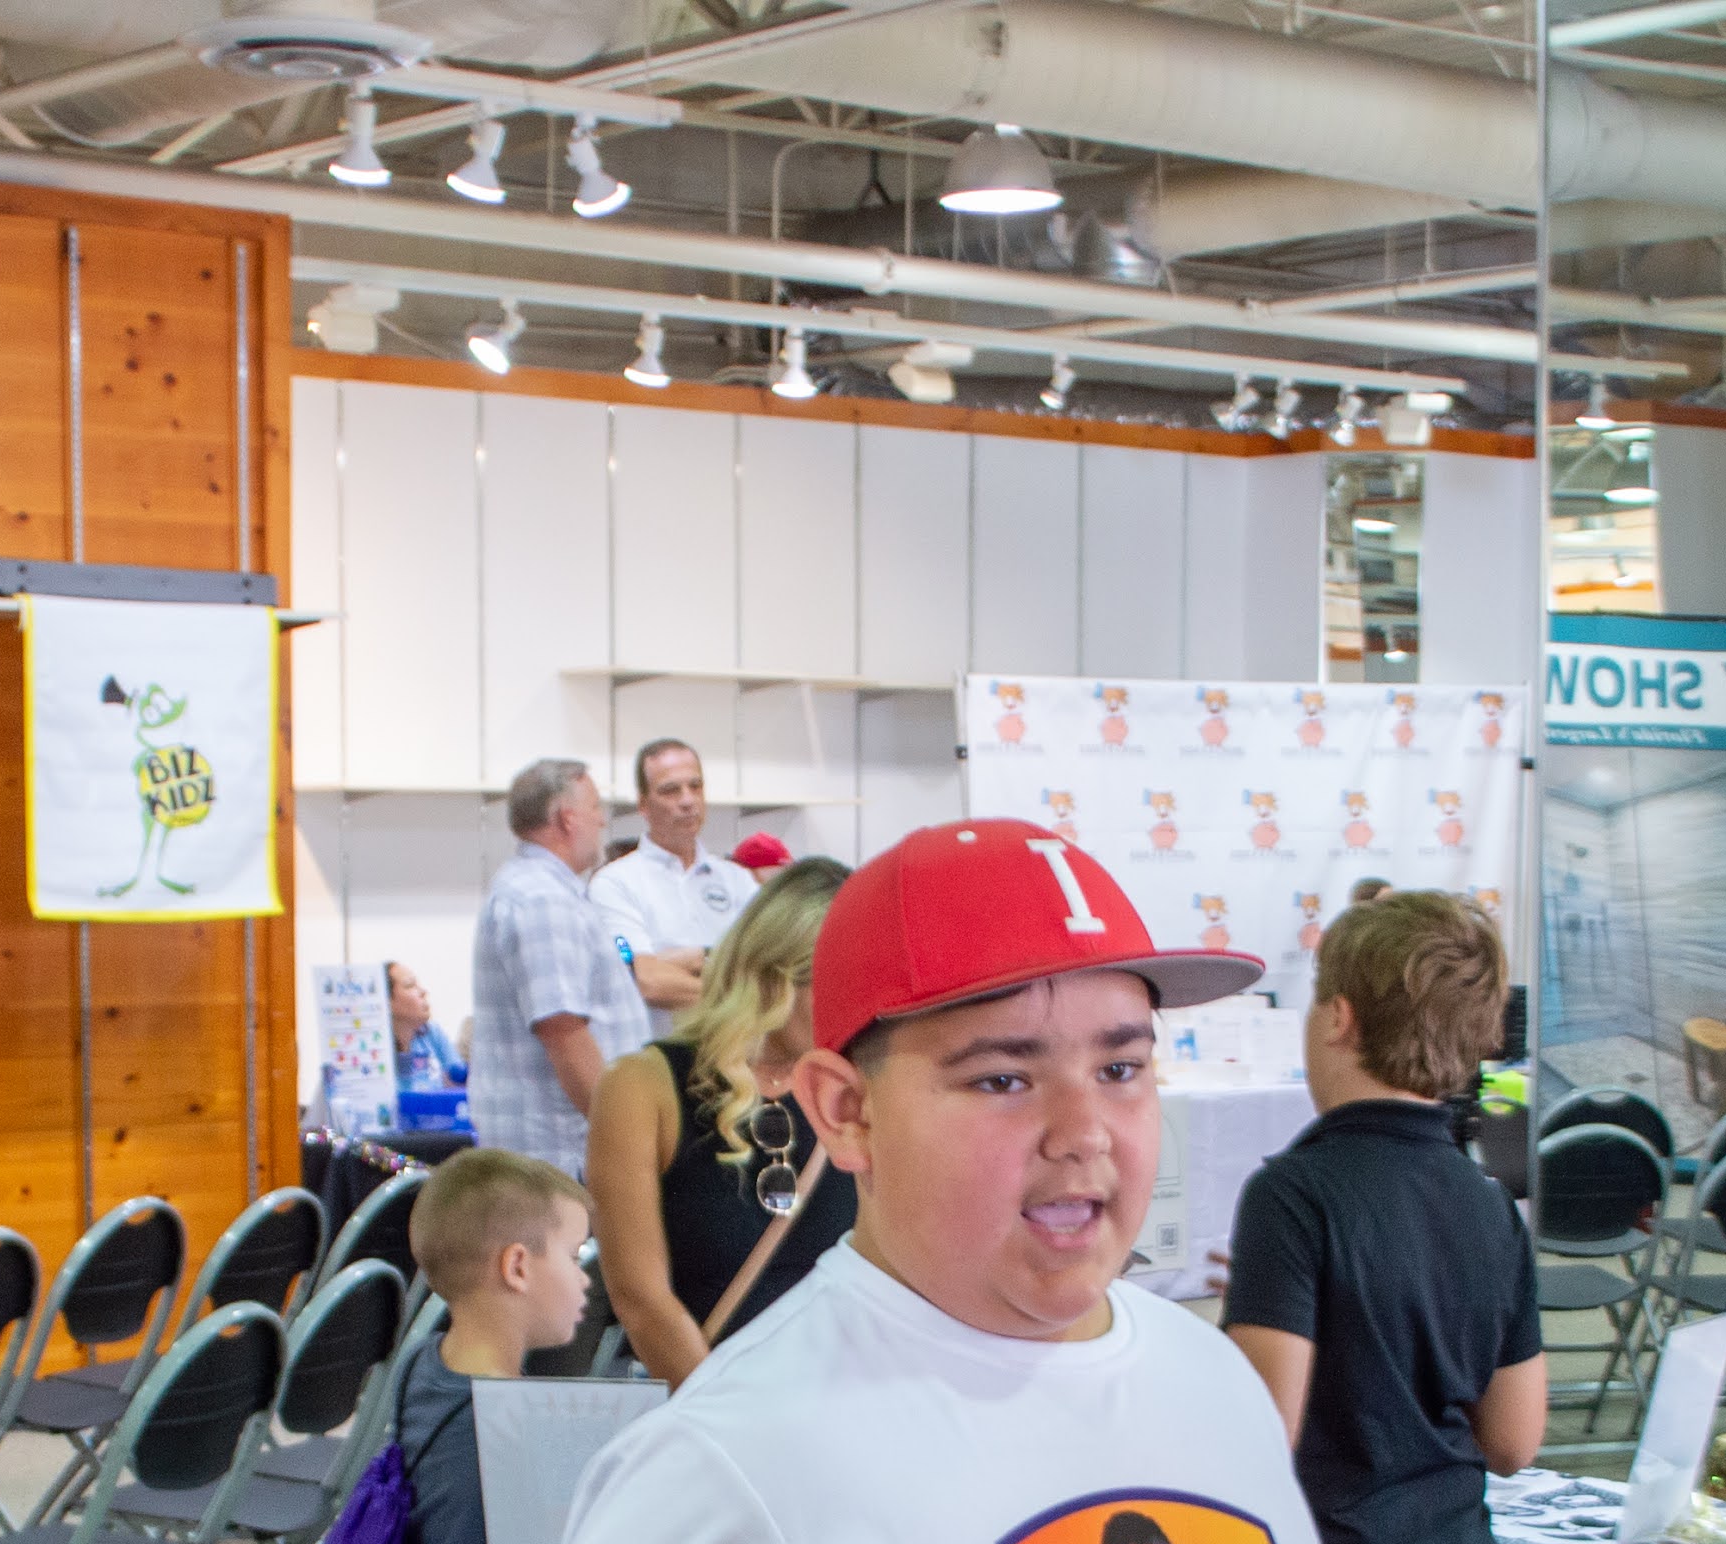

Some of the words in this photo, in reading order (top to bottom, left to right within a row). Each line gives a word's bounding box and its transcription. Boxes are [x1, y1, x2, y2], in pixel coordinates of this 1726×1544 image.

[147, 749, 201, 784] BIZ
[145, 778, 215, 816] KIDZ
[1025, 839, 1105, 933] I
